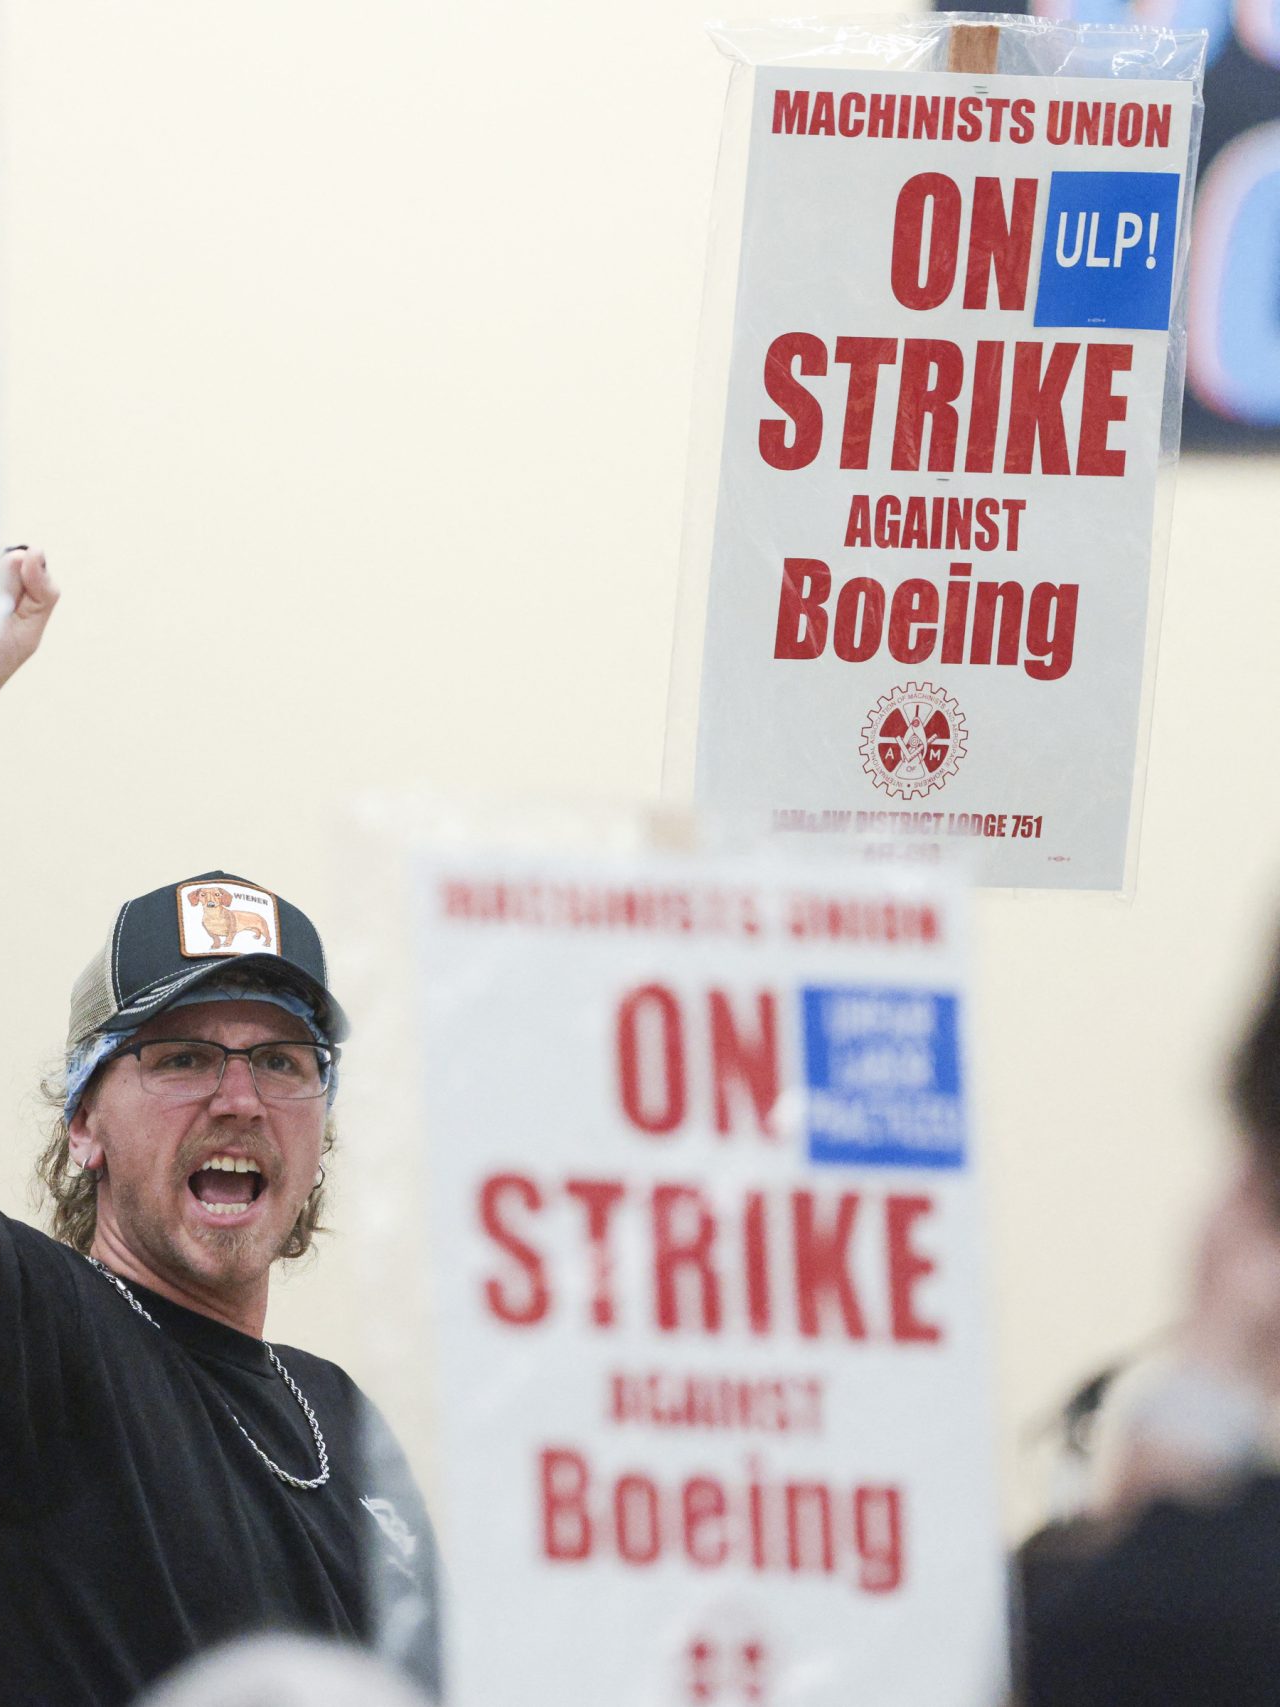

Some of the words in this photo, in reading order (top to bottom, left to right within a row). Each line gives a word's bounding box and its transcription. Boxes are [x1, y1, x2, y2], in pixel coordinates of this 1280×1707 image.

[772, 90, 1036, 146] MACHINISTS
[1047, 101, 1172, 149] UNION
[891, 172, 1038, 311] ON
[1055, 211, 1160, 270] ULP!
[758, 332, 1134, 477] STRIKE
[844, 495, 1027, 552] AGAINST
[774, 557, 1080, 681] Boeing
[885, 747, 895, 760] A
[929, 749, 941, 761] M
[947, 813, 1008, 838] LODGE
[1011, 815, 1043, 839] 751
[233, 892, 269, 906] WIENER
[615, 982, 781, 1138] ON
[479, 1173, 942, 1346] STRIKE
[539, 1449, 906, 1596] Boeing
